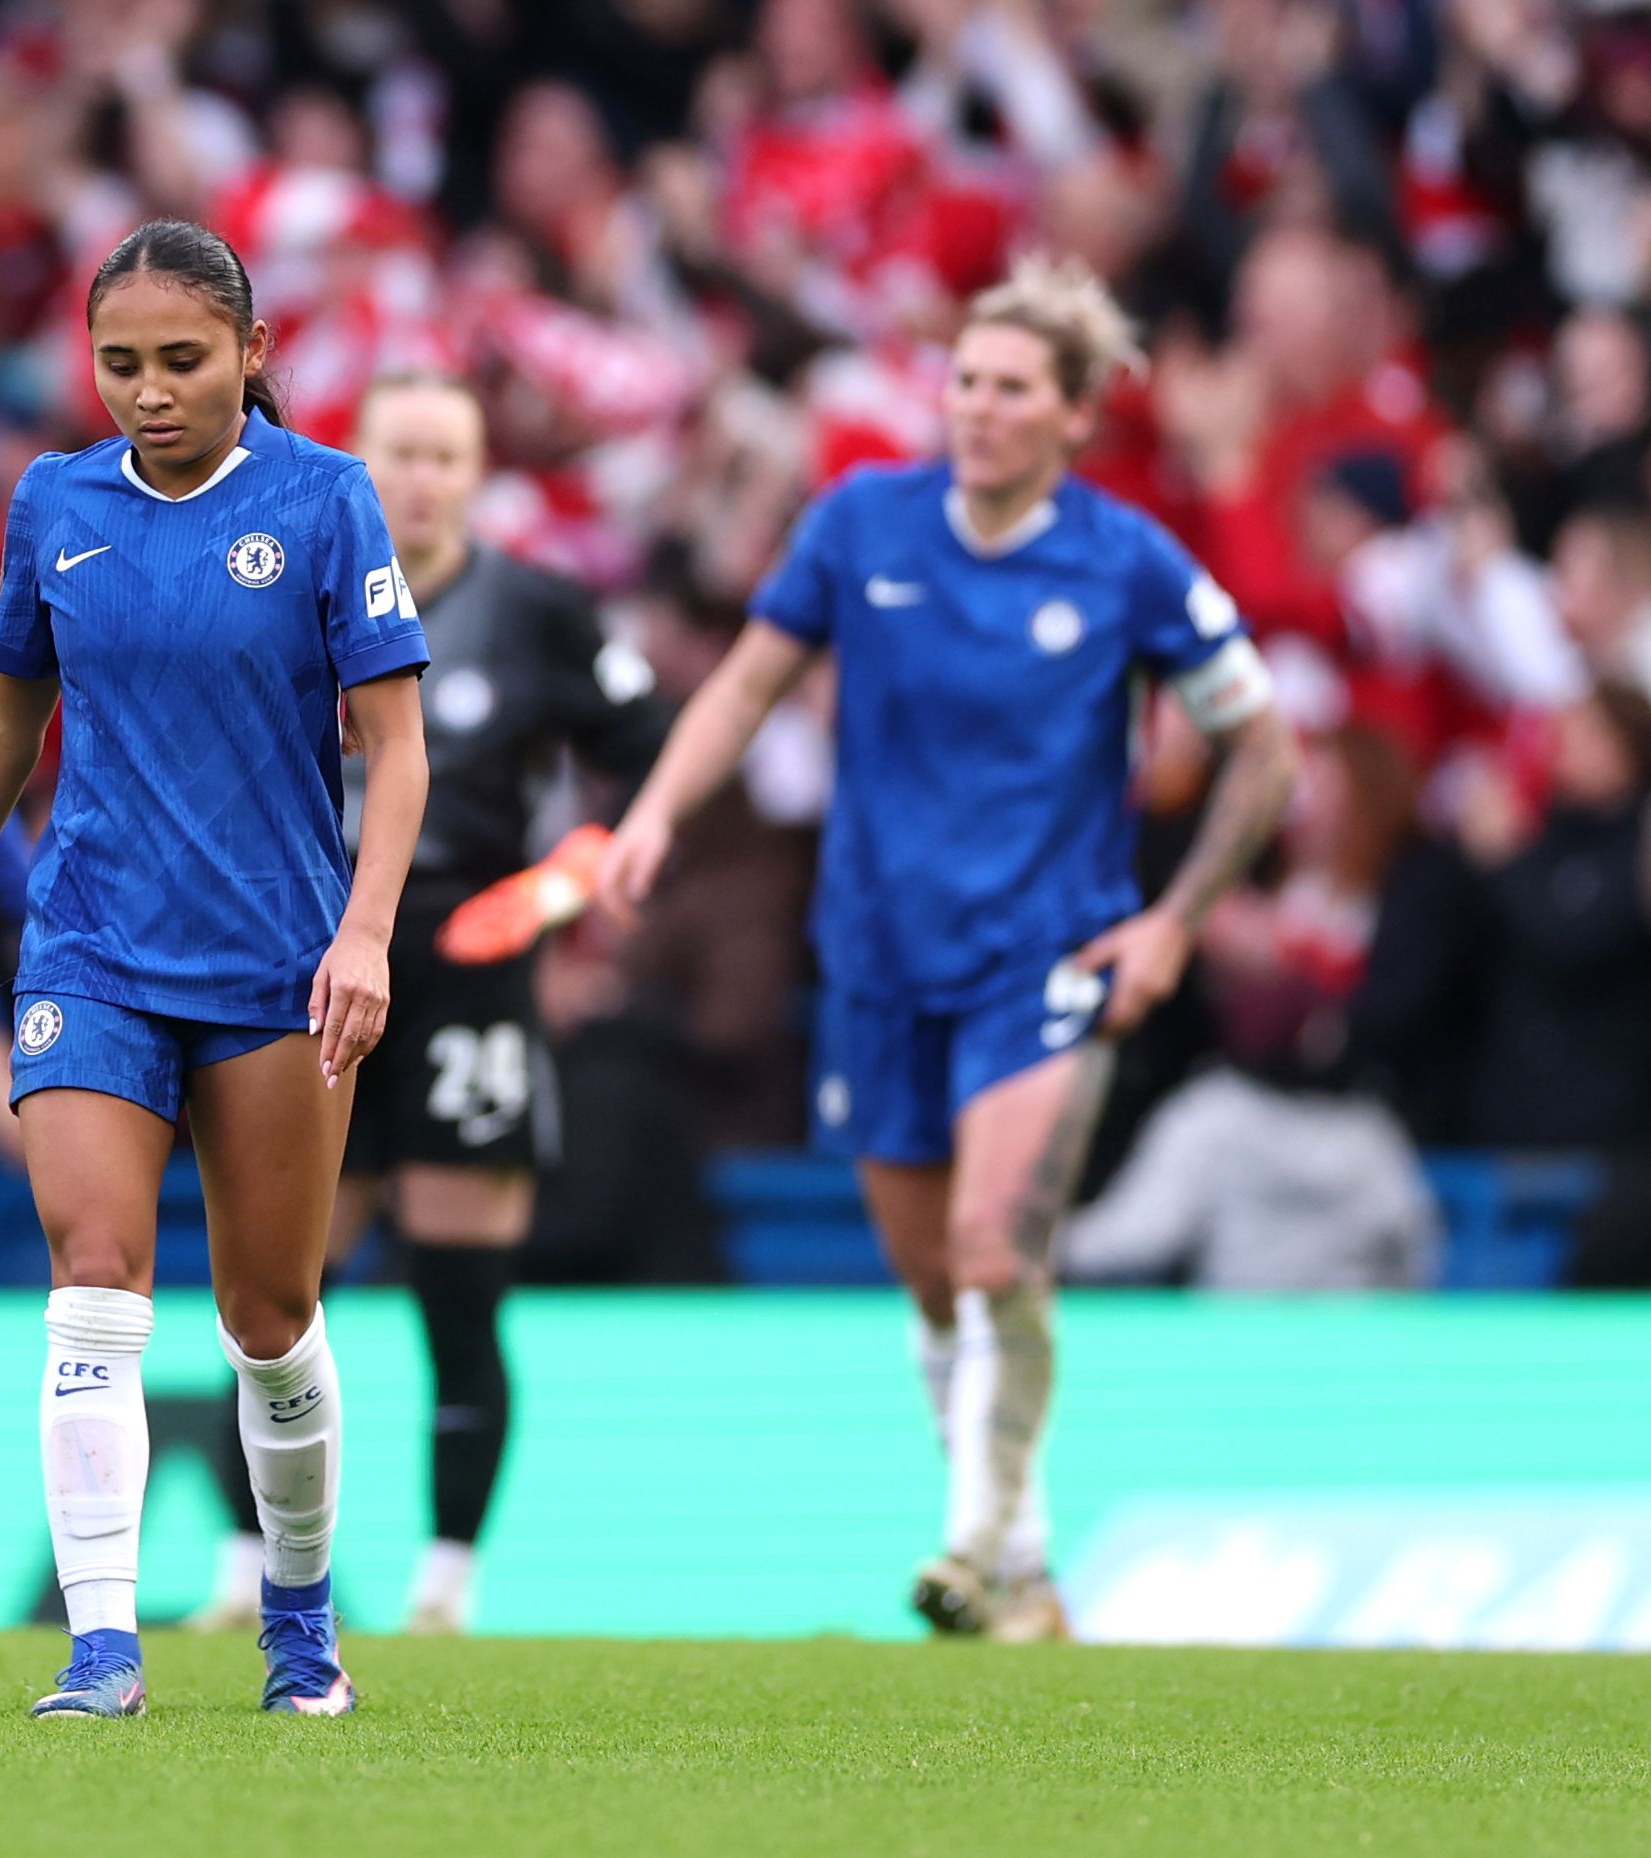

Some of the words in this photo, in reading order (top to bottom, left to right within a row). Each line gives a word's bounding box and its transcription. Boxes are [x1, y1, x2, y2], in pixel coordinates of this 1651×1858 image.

[238, 535, 274, 548] CHELSEA
[59, 1361, 109, 1380] CFC
[270, 1385, 321, 1411] CFC
